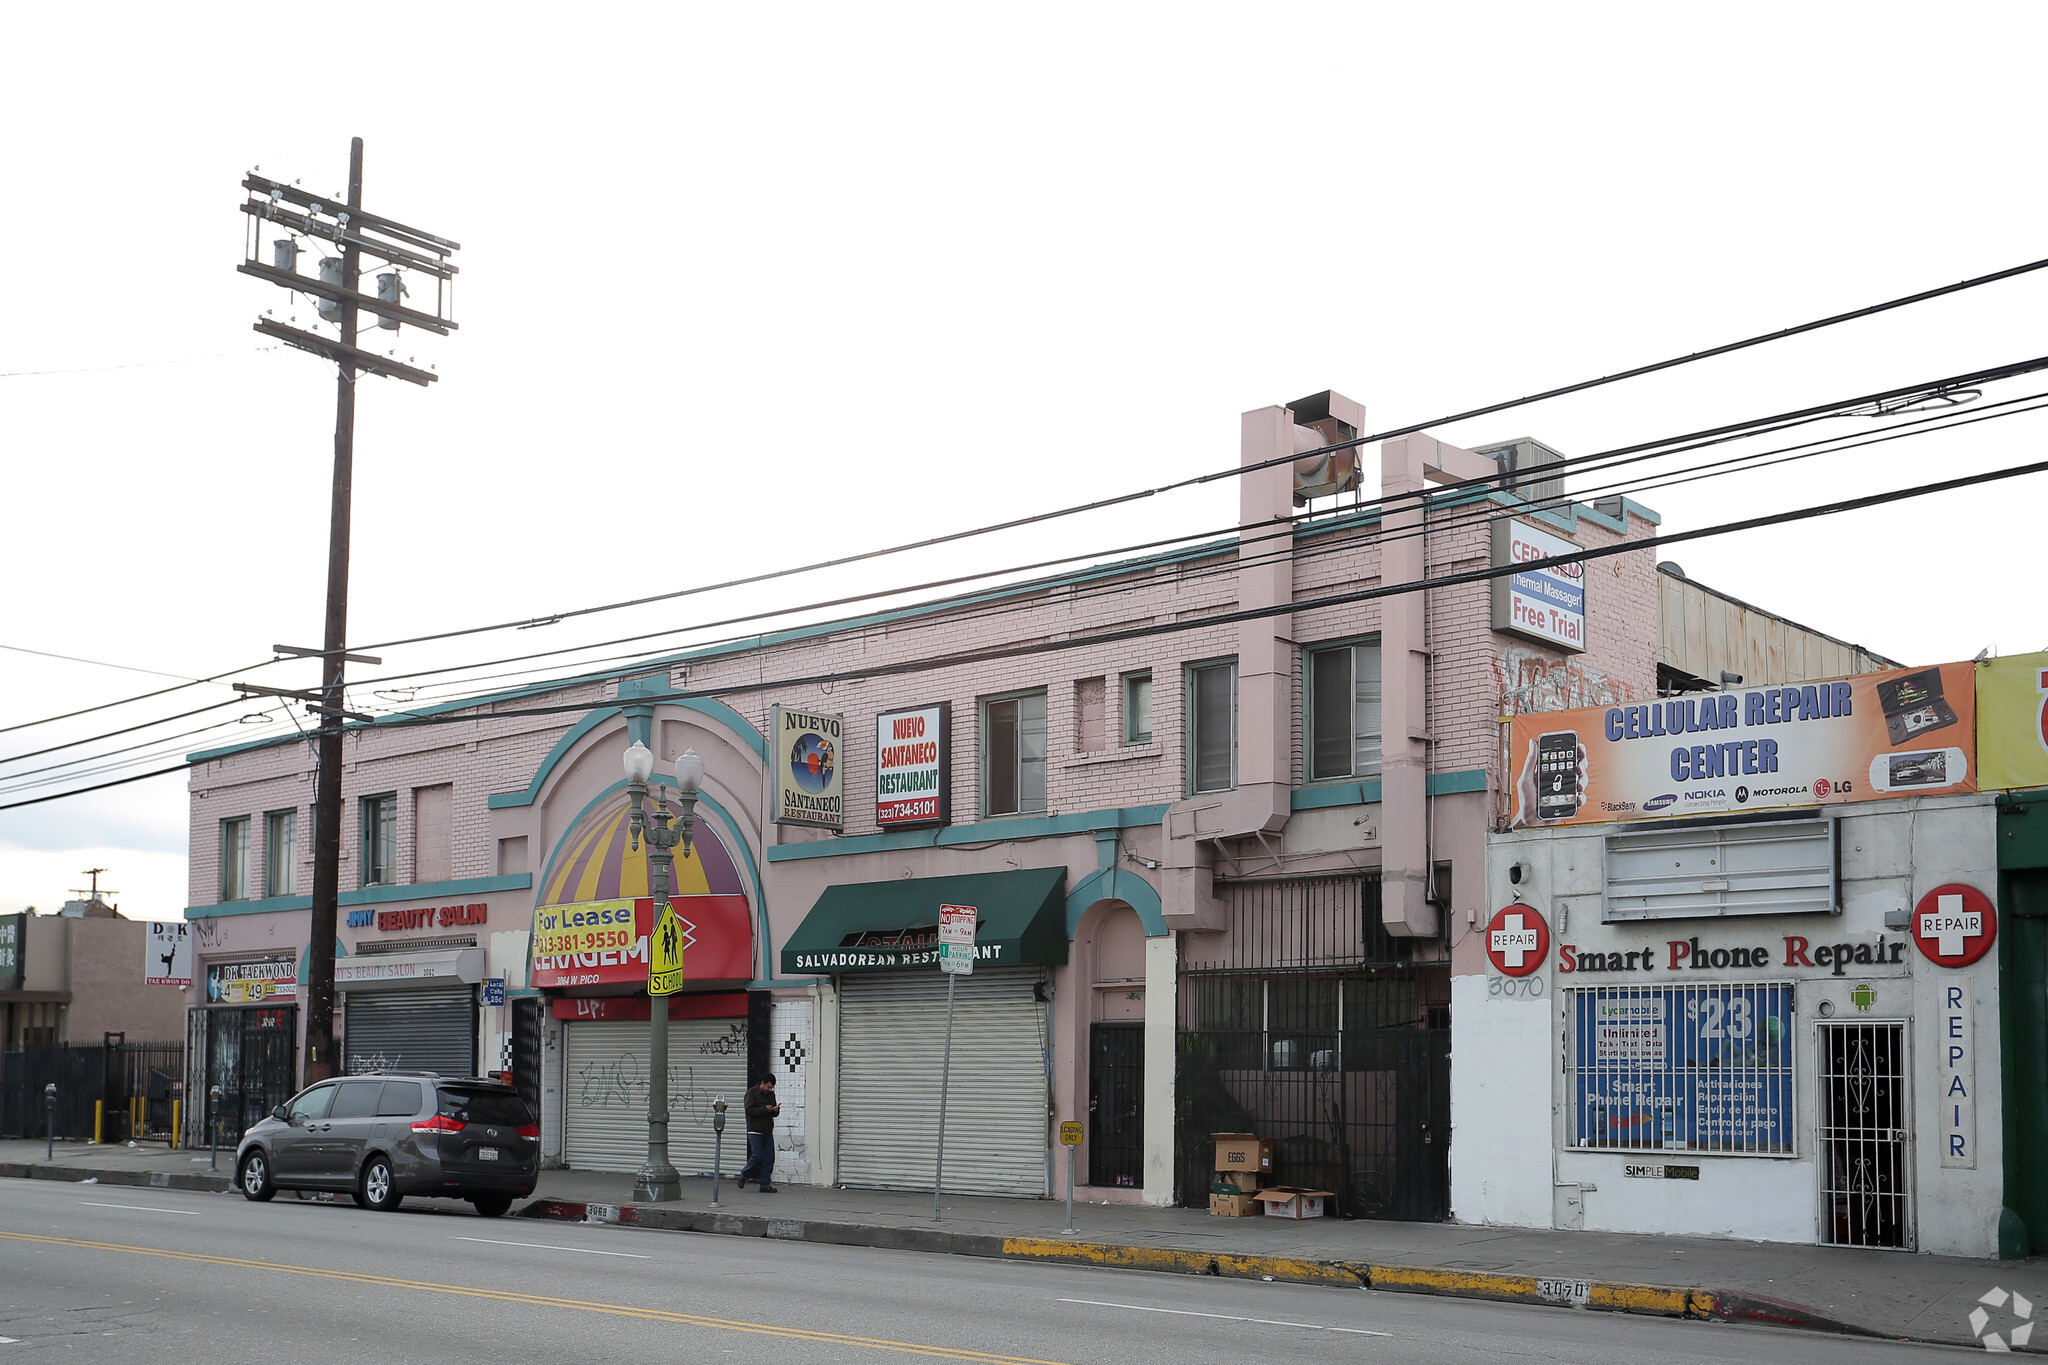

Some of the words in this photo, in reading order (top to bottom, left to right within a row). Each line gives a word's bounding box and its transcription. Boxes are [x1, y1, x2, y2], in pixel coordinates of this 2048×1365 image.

[1512, 573, 1543, 594] Thermal
[1544, 581, 1582, 607] Massager!
[1513, 596, 1545, 629] Free
[1549, 608, 1580, 641] Trial
[1604, 694, 1737, 742] CELLULAR
[1744, 681, 1852, 727] REPAIR
[785, 712, 840, 738] NUEVO
[893, 715, 925, 741] NUEVO
[881, 741, 937, 769] SANTANECO
[1670, 738, 1778, 782] CENTER
[879, 769, 938, 795] RESTAURANT
[1834, 781, 1852, 793] LG
[1684, 789, 1726, 800] NOKIA
[1753, 786, 1808, 798] MOTOROLA
[784, 788, 840, 813] SANTANECO
[1607, 802, 1636, 812] BlackBerry
[1647, 798, 1674, 807] SAMSUNG
[1684, 800, 1710, 808] Connecting
[1710, 798, 1727, 807] People
[784, 808, 840, 823] RESTAURANT
[345, 909, 375, 928] JIMMY
[377, 908, 436, 931] BEAUTY
[438, 903, 488, 927] SALON
[538, 912, 557, 931] For
[562, 908, 631, 929] Lease
[941, 914, 951, 923] NO
[951, 916, 974, 924] STOPPING
[1924, 917, 1979, 931] REPAIR
[960, 928, 972, 936] 9AM
[1493, 933, 1536, 946] REPAIR
[539, 930, 629, 953] 213-381-9550
[796, 953, 895, 968] SALVADOREAN
[902, 945, 1002, 965] RESTANT
[949, 951, 971, 960] PARKING
[1558, 944, 1655, 973] Smart
[1667, 937, 1769, 971] Phone
[1782, 933, 1906, 976] Repair
[225, 965, 239, 981] DK
[356, 965, 386, 978] BEAUTY
[388, 963, 416, 977] SALON
[570, 975, 577, 985] W
[580, 974, 600, 985] PICO
[652, 971, 682, 991] SCHOOL
[1488, 975, 1544, 997] 3070
[1602, 1006, 1659, 1017] Lycamobie
[1603, 1028, 1658, 1038] Unlimied
[1947, 986, 1967, 1158] REPAIR
[1587, 1093, 1630, 1106] Phone
[1635, 1093, 1684, 1109] Repar
[1060, 1126, 1083, 1134] LOADING
[1751, 1119, 1777, 1129] pago
[1228, 1152, 1245, 1163] EGGS
[1625, 1165, 1663, 1177] SIMPLE
[1665, 1166, 1698, 1179] Mobile
[1543, 1282, 1584, 1298] 3070
